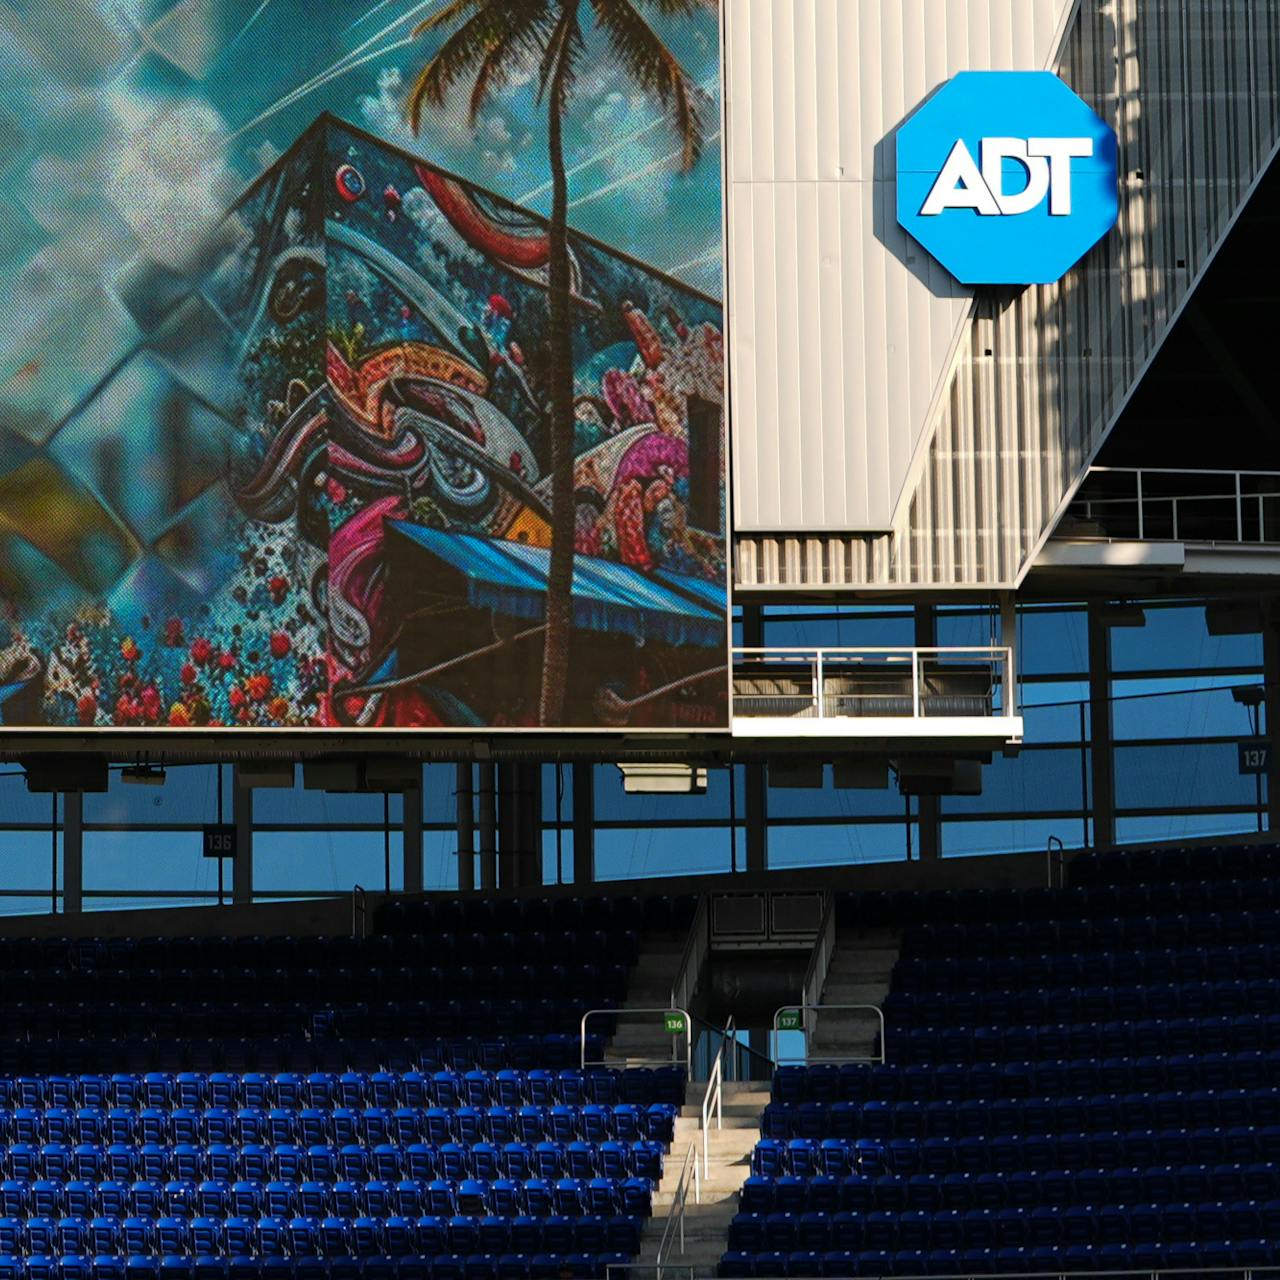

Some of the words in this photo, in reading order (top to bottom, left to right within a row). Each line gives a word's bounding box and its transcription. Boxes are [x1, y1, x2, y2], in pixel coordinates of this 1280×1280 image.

[919, 136, 1094, 216] ADT
[1244, 750, 1267, 767] 137
[207, 834, 232, 850] 136
[667, 1020, 683, 1029] 136
[782, 1017, 797, 1026] 137
